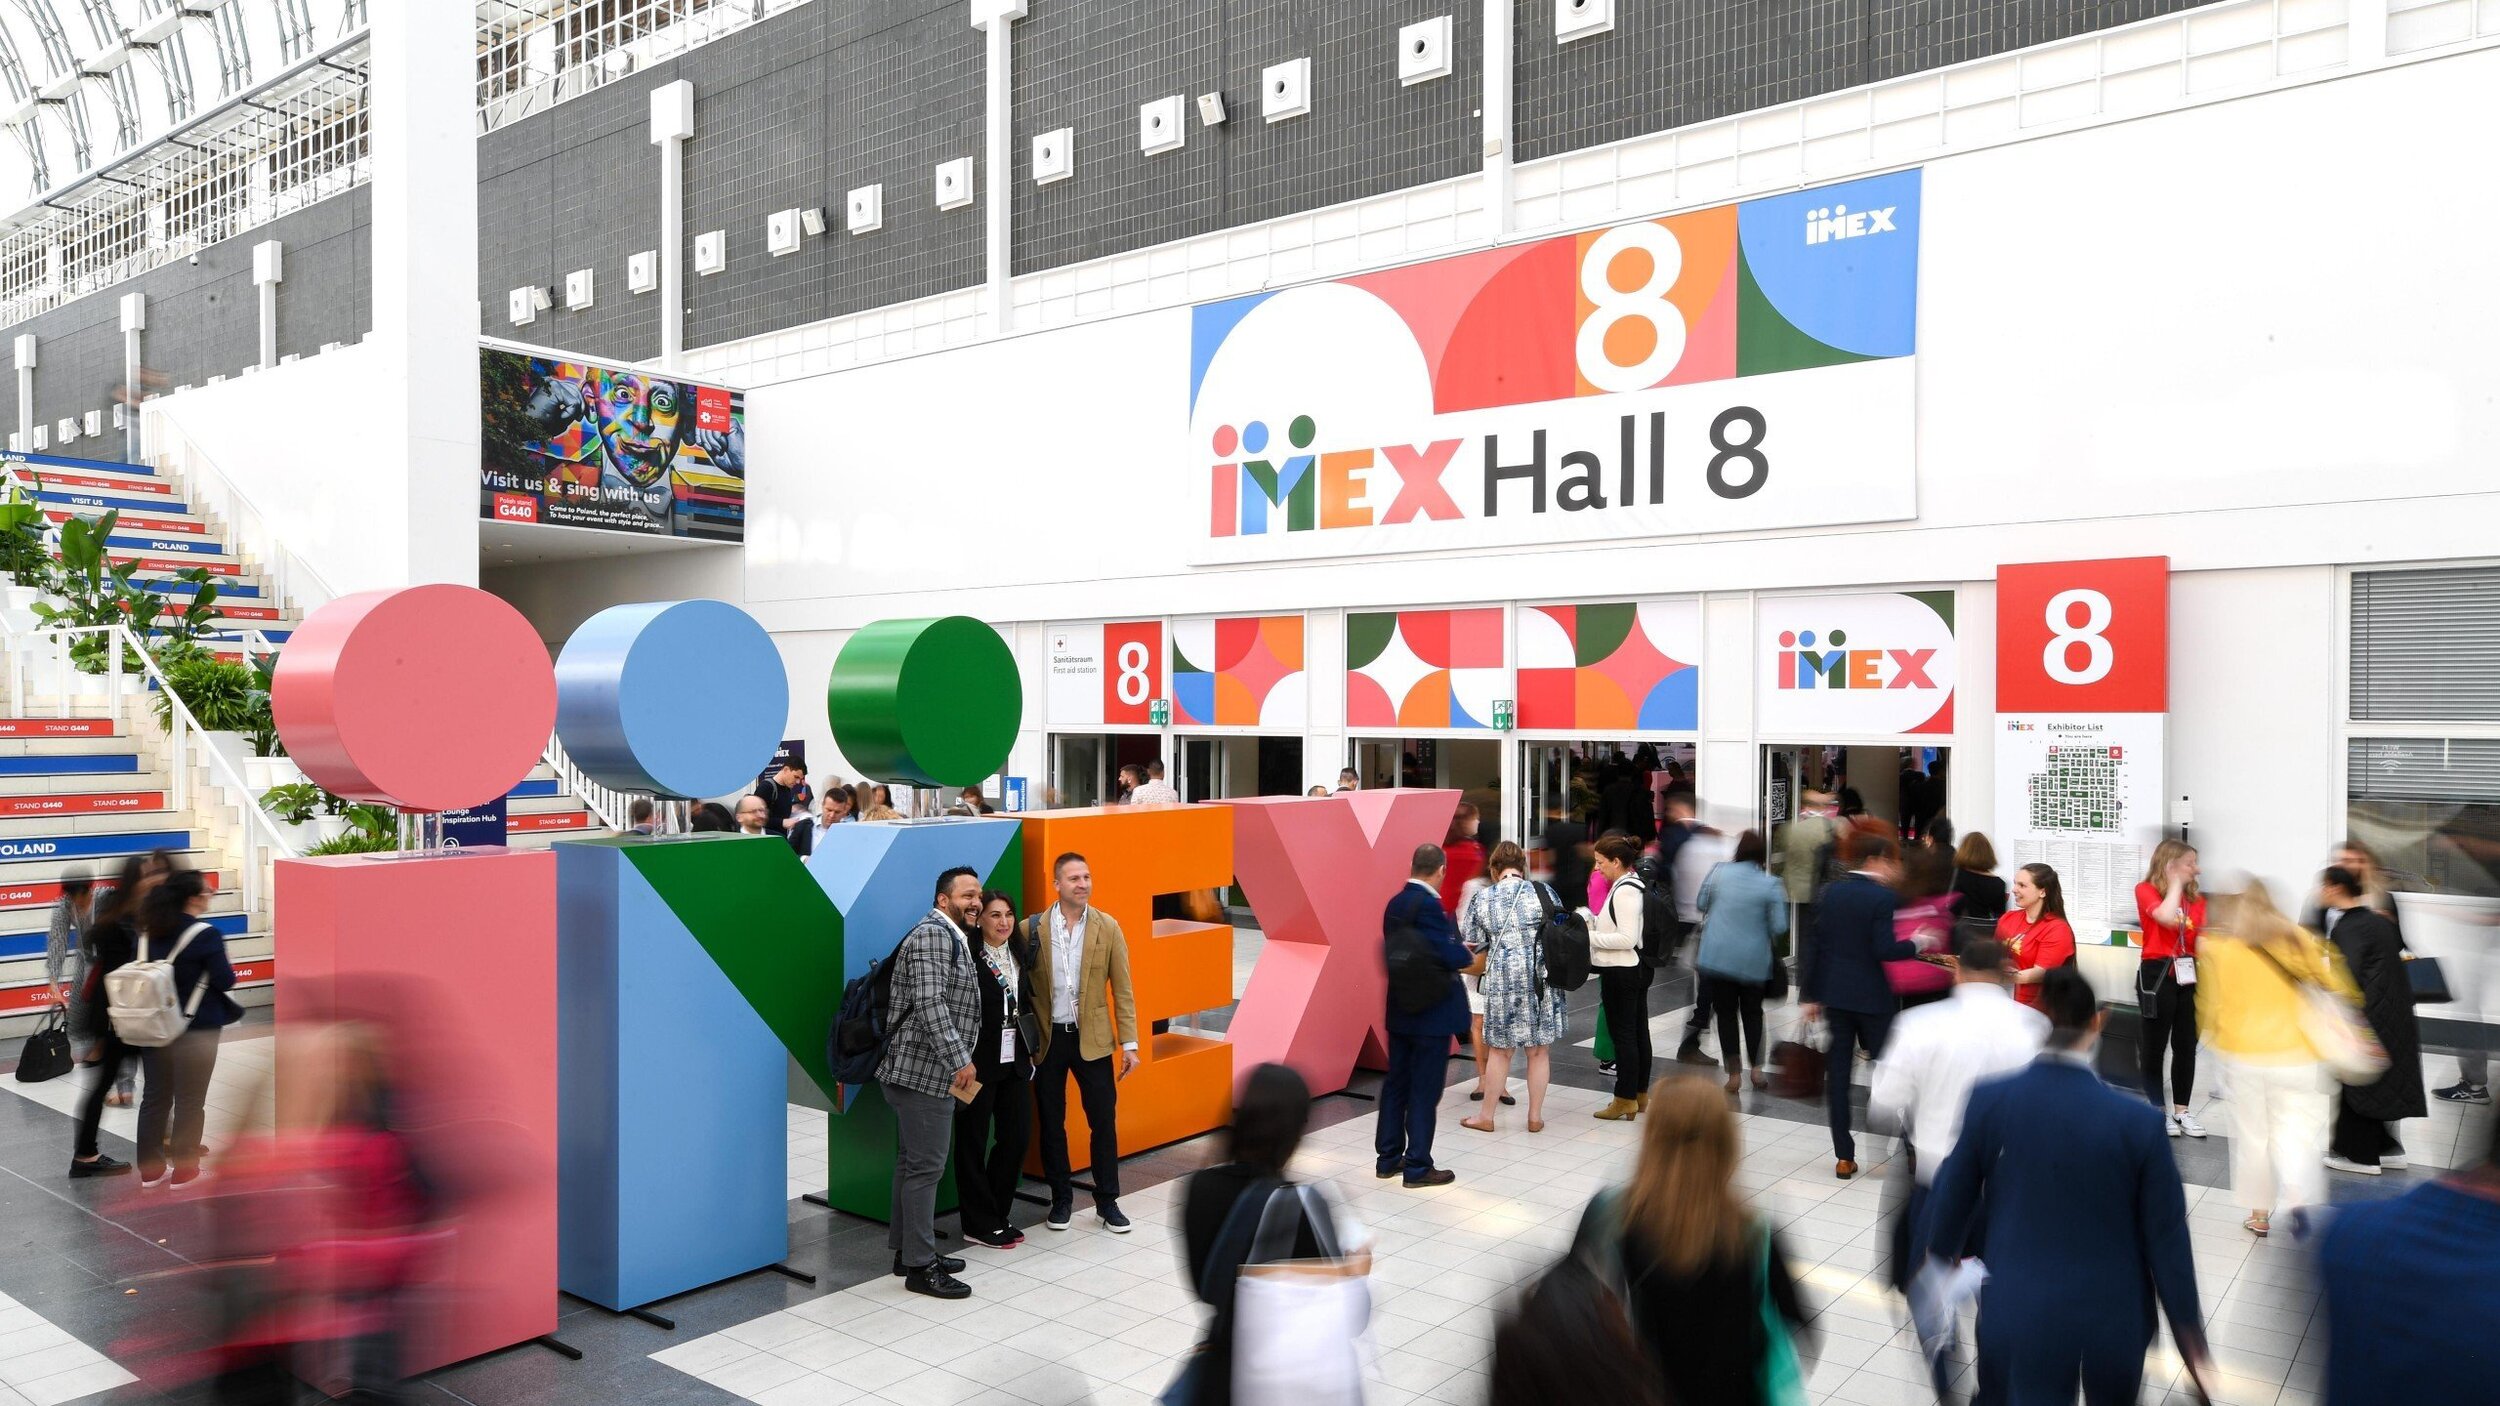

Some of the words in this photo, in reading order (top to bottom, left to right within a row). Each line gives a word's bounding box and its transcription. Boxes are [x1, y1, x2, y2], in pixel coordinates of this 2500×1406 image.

[1576, 220, 1687, 393] 8
[1484, 411, 1665, 518] Hall
[1706, 405, 1769, 500] 8
[481, 469, 519, 489] Visit
[524, 478, 543, 491] us
[548, 477, 562, 494] &
[567, 480, 600, 502] sing
[604, 484, 639, 504] with
[643, 492, 660, 504] us
[71, 497, 92, 505] VISIT
[93, 499, 104, 507] US
[516, 498, 533, 506] stand
[499, 504, 532, 518] G440
[549, 504, 567, 512] Come
[599, 509, 609, 517] the
[610, 511, 631, 519] perfect
[557, 512, 571, 520] host
[618, 518, 632, 527] style
[152, 541, 189, 551] POLAND
[148, 562, 164, 570] STAND
[2043, 588, 2114, 686] 8
[1053, 655, 1094, 664] Sanitätsraum
[1053, 666, 1066, 674] First
[1066, 666, 1076, 674] aid
[1077, 666, 1097, 674] station
[1116, 641, 1151, 706] 8
[2048, 723, 2085, 731] Exhibitor
[2088, 723, 2103, 731] List
[14, 802, 41, 810] STAND
[42, 801, 63, 809] G440
[93, 799, 118, 807] STAND
[442, 808, 470, 817] Lounge
[442, 815, 481, 825] Inspiration
[482, 814, 497, 822] Hub
[9, 892, 32, 900] G440
